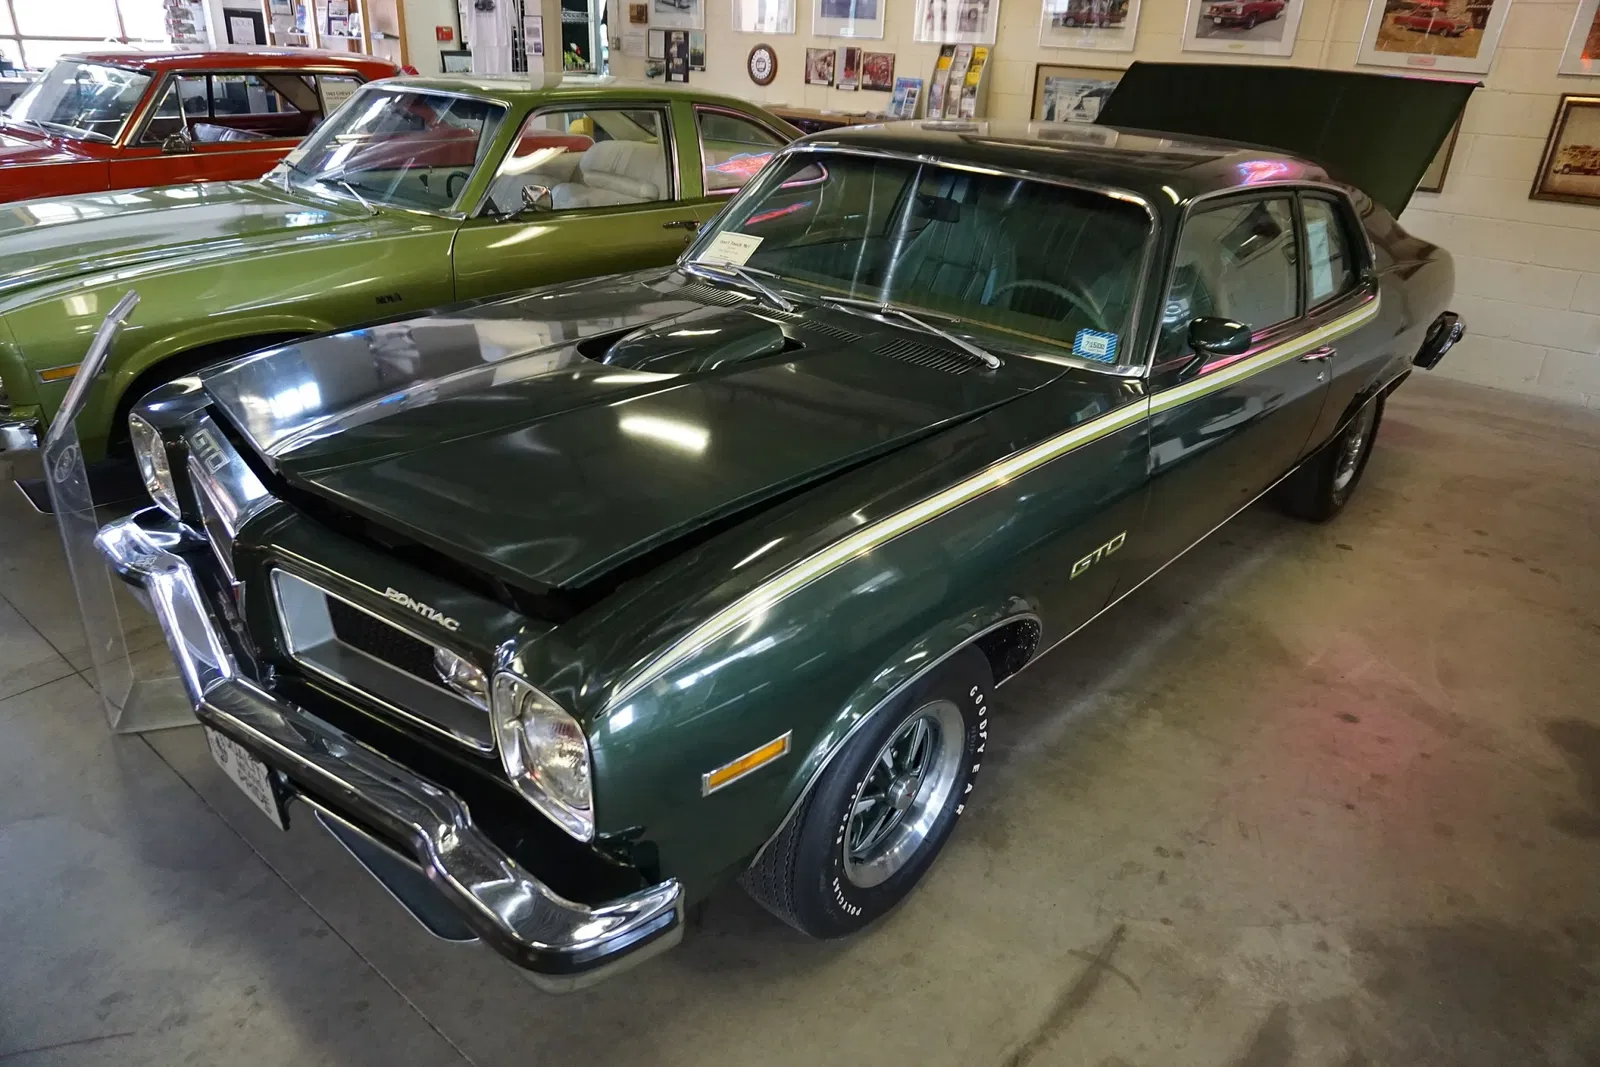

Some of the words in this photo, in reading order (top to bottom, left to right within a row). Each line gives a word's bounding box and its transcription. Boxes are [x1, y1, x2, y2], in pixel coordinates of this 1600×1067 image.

[375, 292, 403, 305] NOVA
[190, 428, 230, 474] GTO
[1069, 530, 1127, 580] GTO
[385, 586, 461, 632] PONTIAC
[956, 685, 988, 816] GOODYEAR
[832, 876, 862, 916] POLYGLAS
